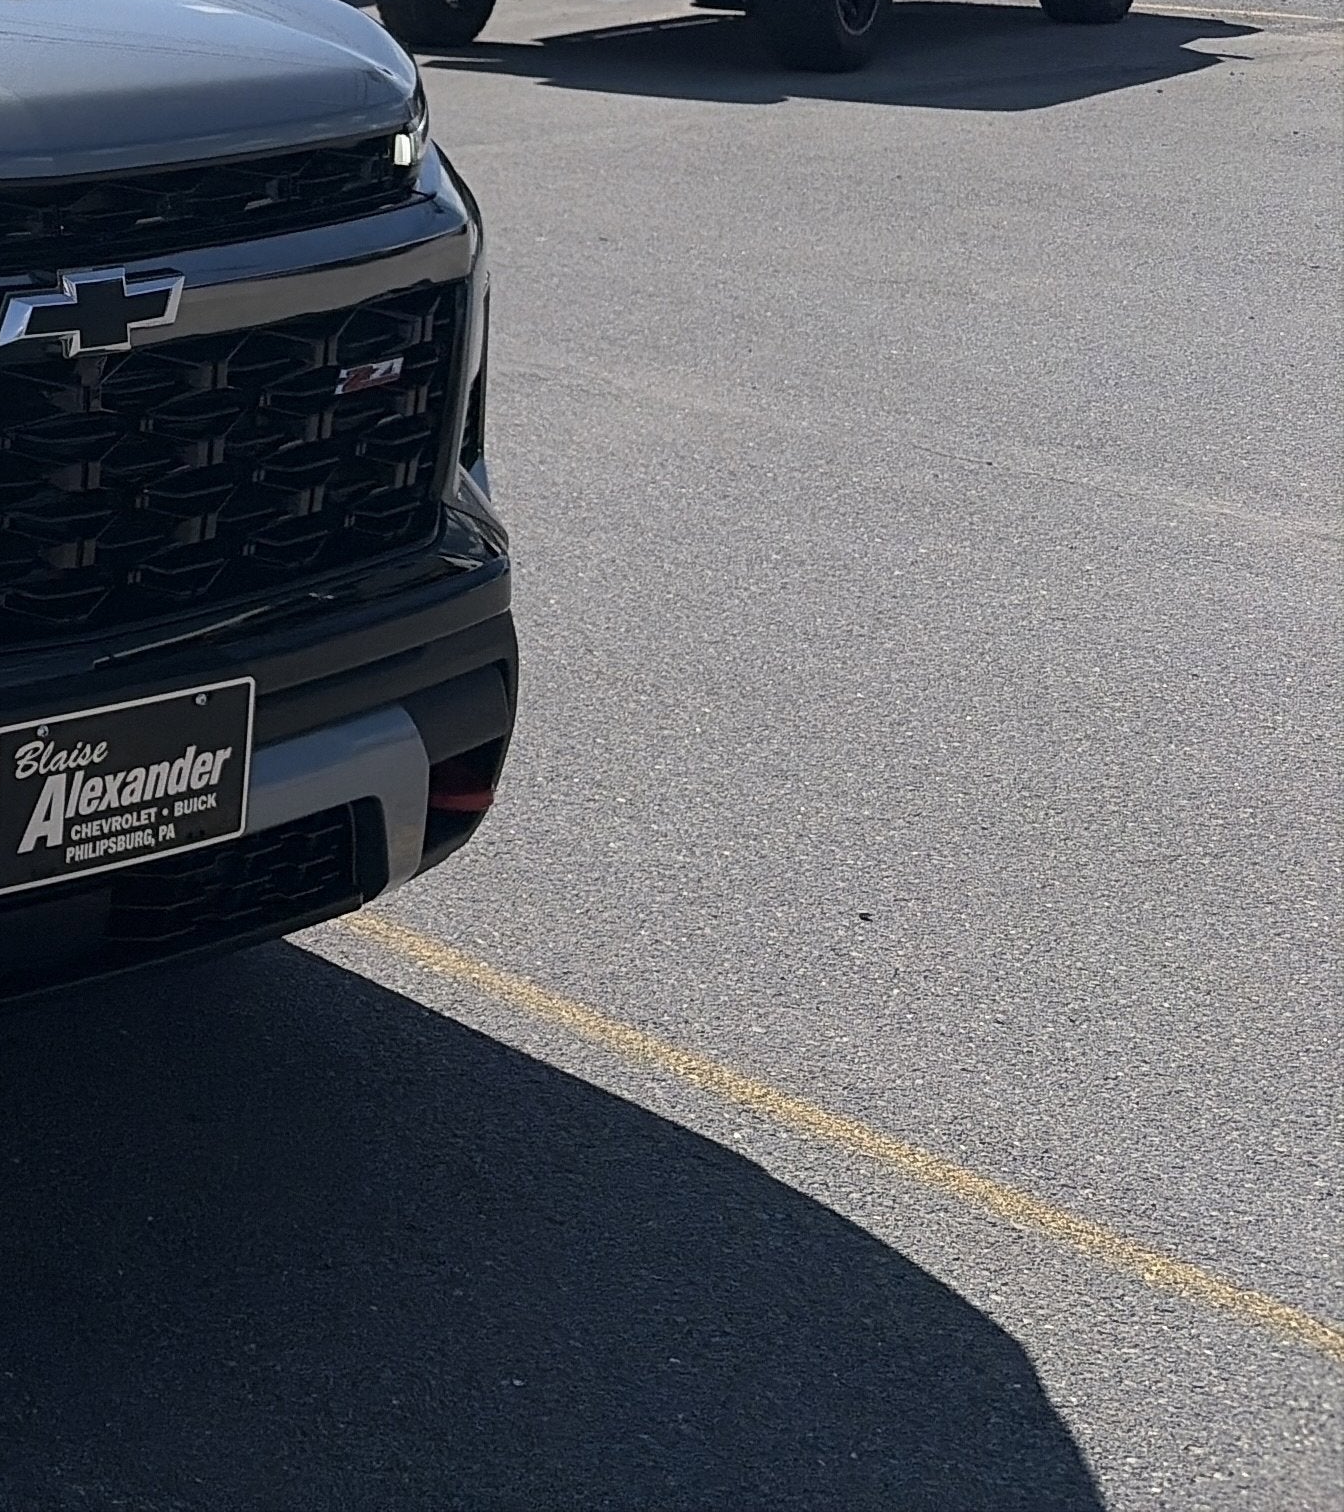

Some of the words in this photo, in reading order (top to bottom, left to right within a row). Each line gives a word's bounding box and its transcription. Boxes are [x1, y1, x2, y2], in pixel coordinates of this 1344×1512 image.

[14, 740, 109, 780] Blaise
[16, 744, 233, 855] Alexander
[69, 806, 158, 841] CHEVROLET
[173, 792, 217, 817] BUICK
[65, 829, 156, 864] PHILIPSBURG,
[158, 822, 176, 842] PA
